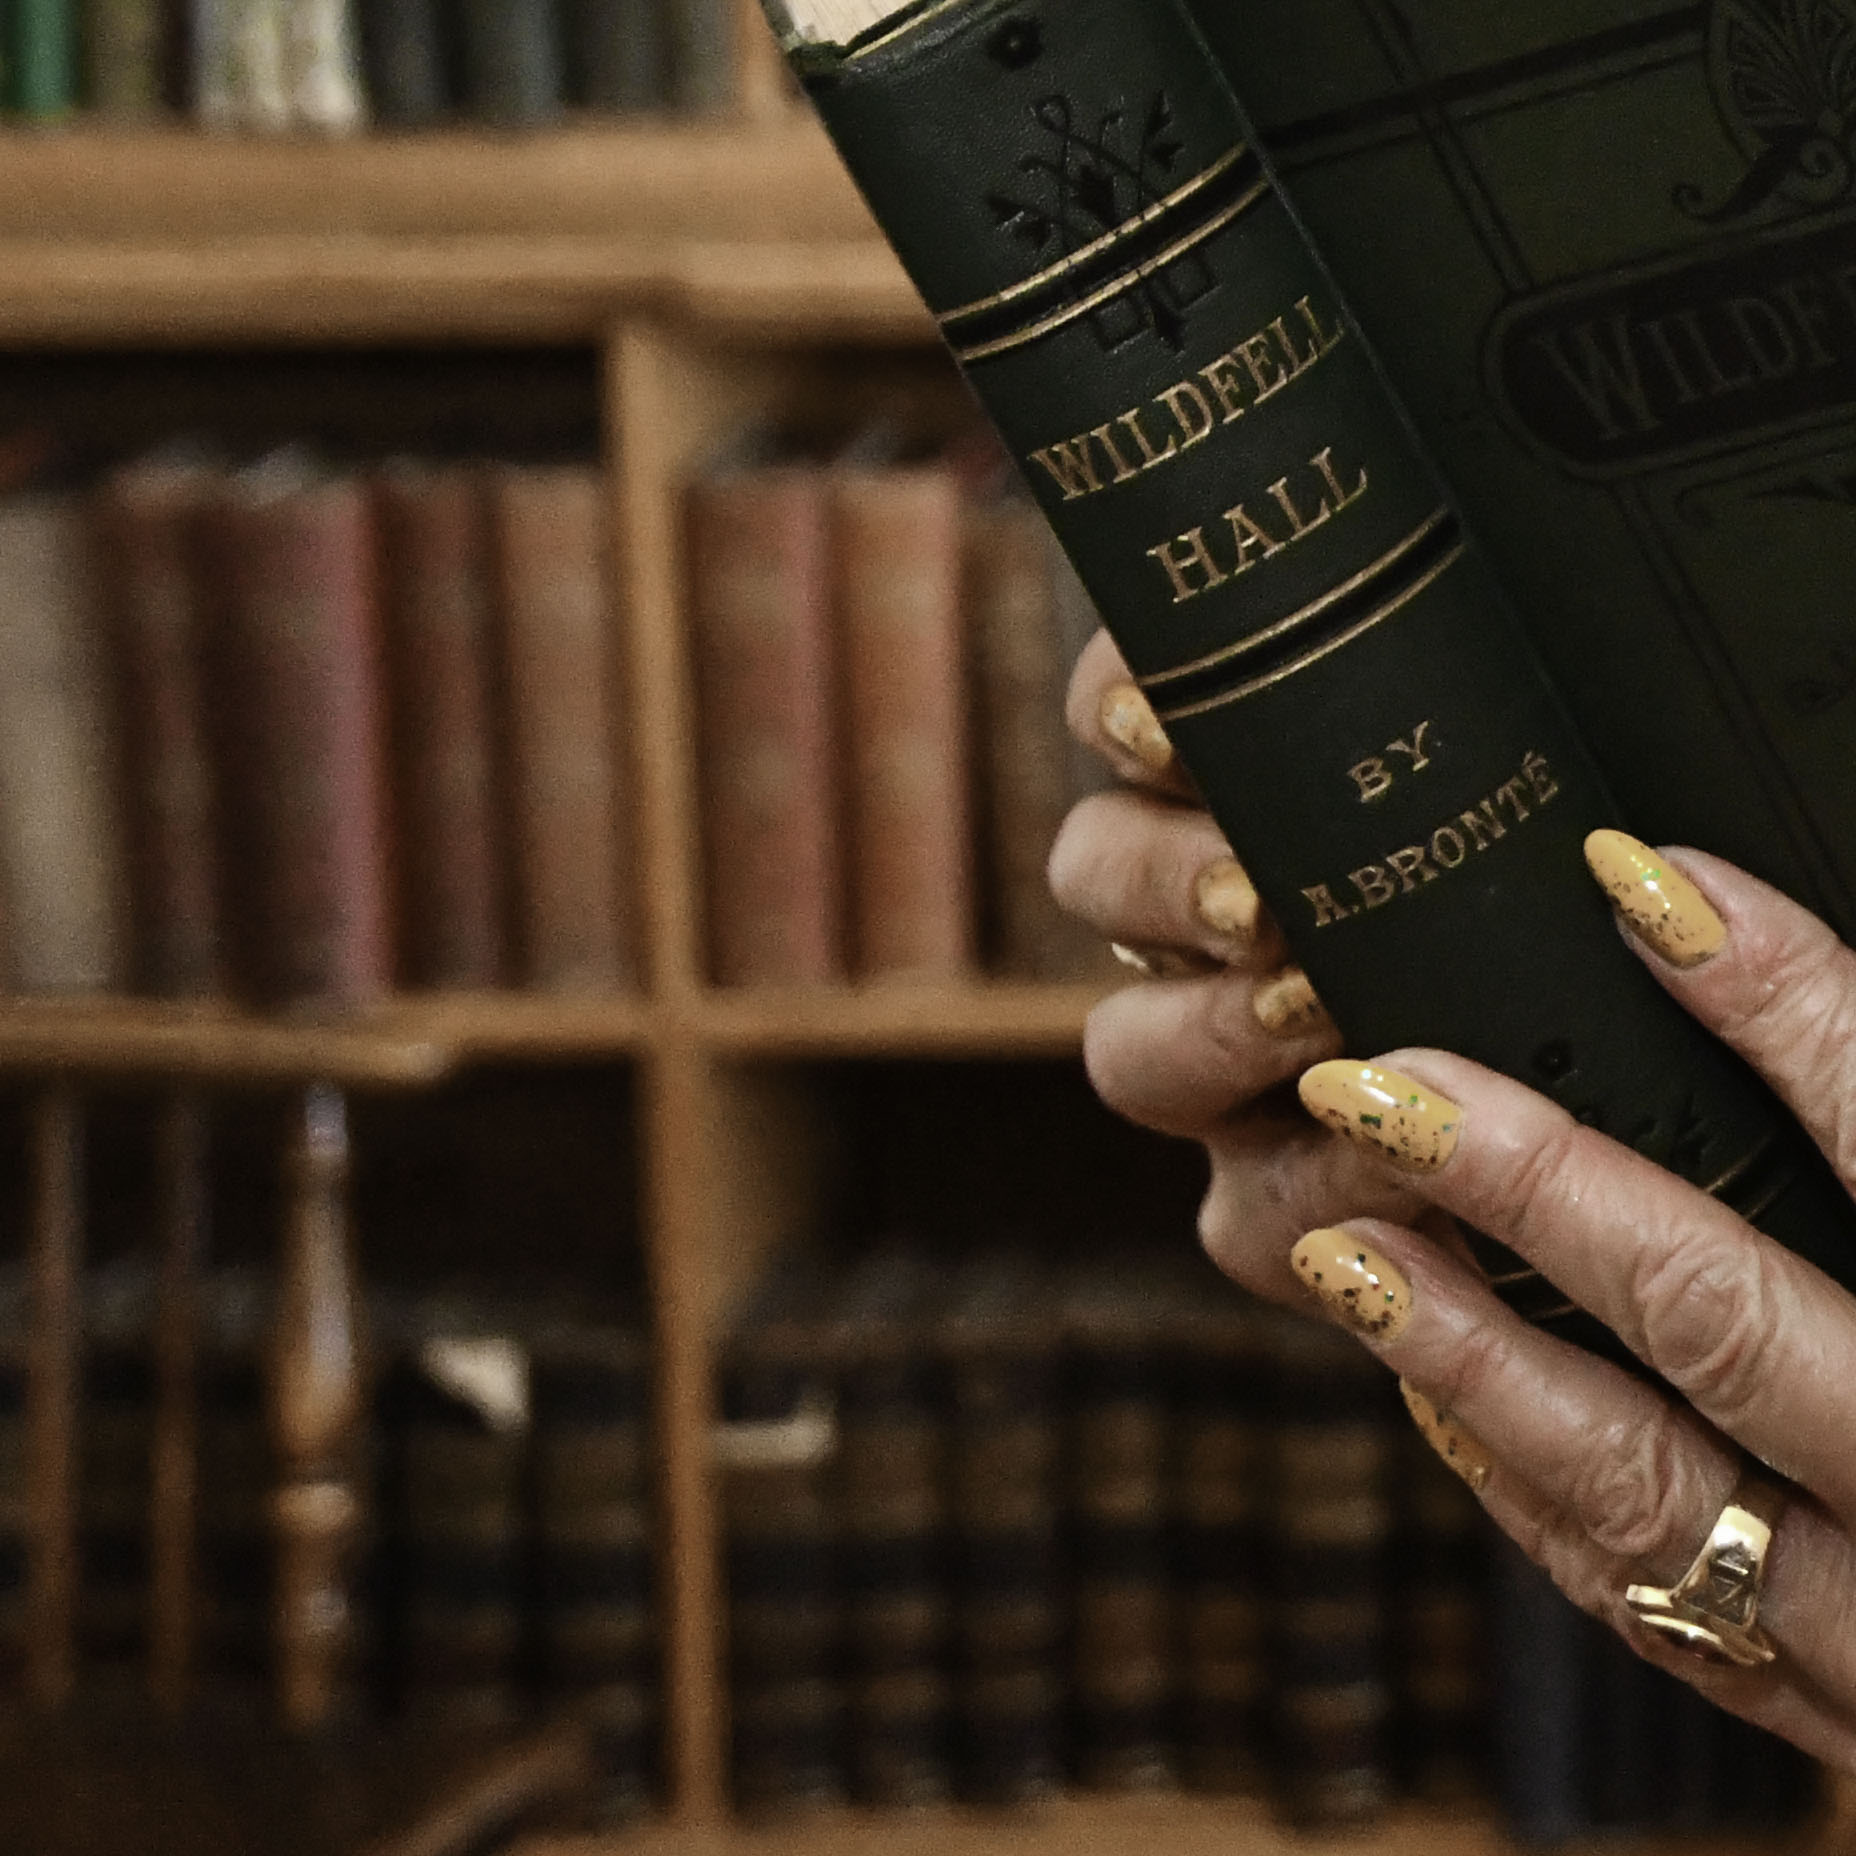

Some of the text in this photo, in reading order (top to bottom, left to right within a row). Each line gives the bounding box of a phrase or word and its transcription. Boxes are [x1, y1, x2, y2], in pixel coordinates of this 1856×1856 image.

[1027, 295, 1345, 500] WILDFELL
[1146, 446, 1367, 603] HALL
[1347, 720, 1429, 802] BY
